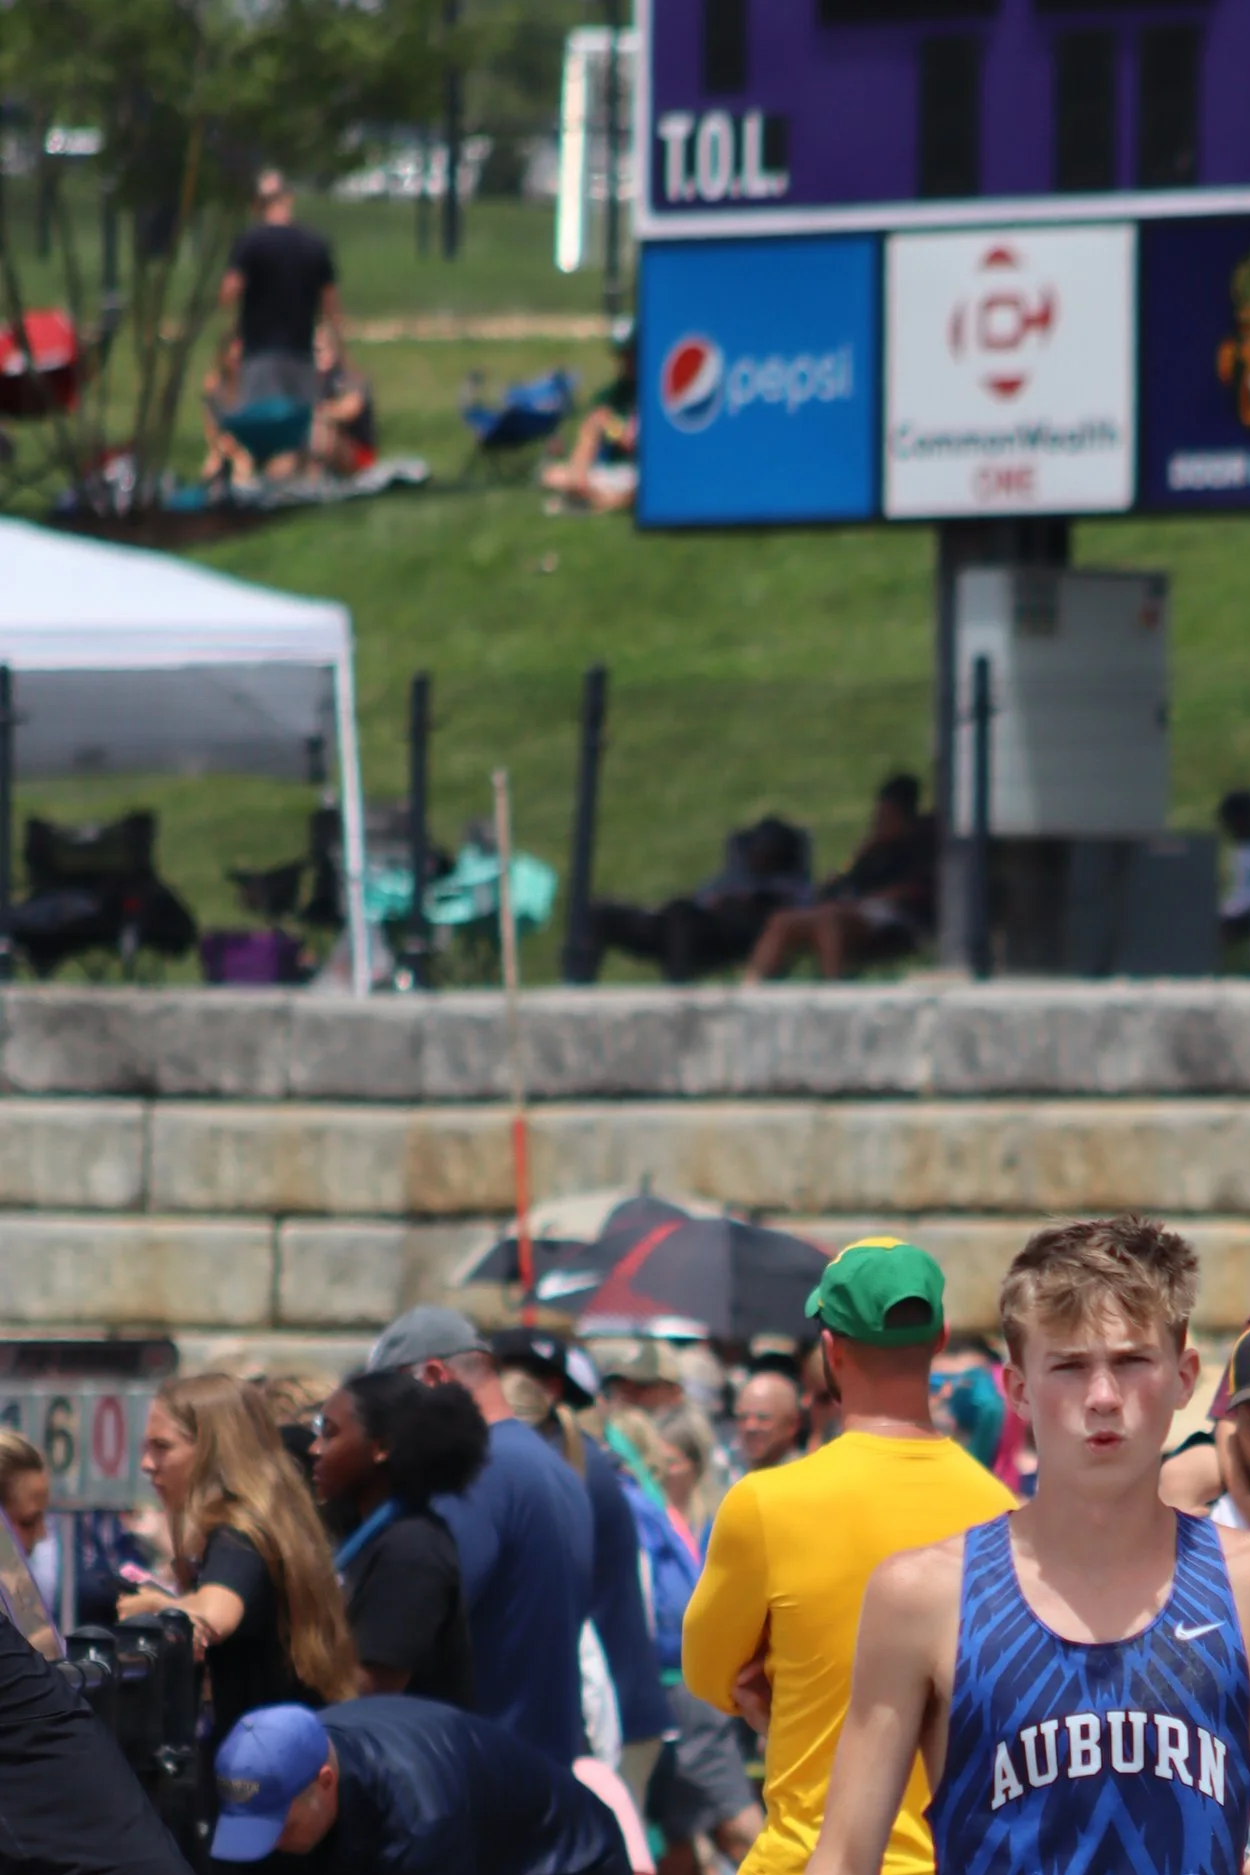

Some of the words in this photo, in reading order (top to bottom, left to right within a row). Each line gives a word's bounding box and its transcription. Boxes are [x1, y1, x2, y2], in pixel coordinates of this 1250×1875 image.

[658, 108, 789, 203] T.O.L.
[728, 350, 854, 416] pepsi
[990, 1710, 1227, 1812] AUBURN
